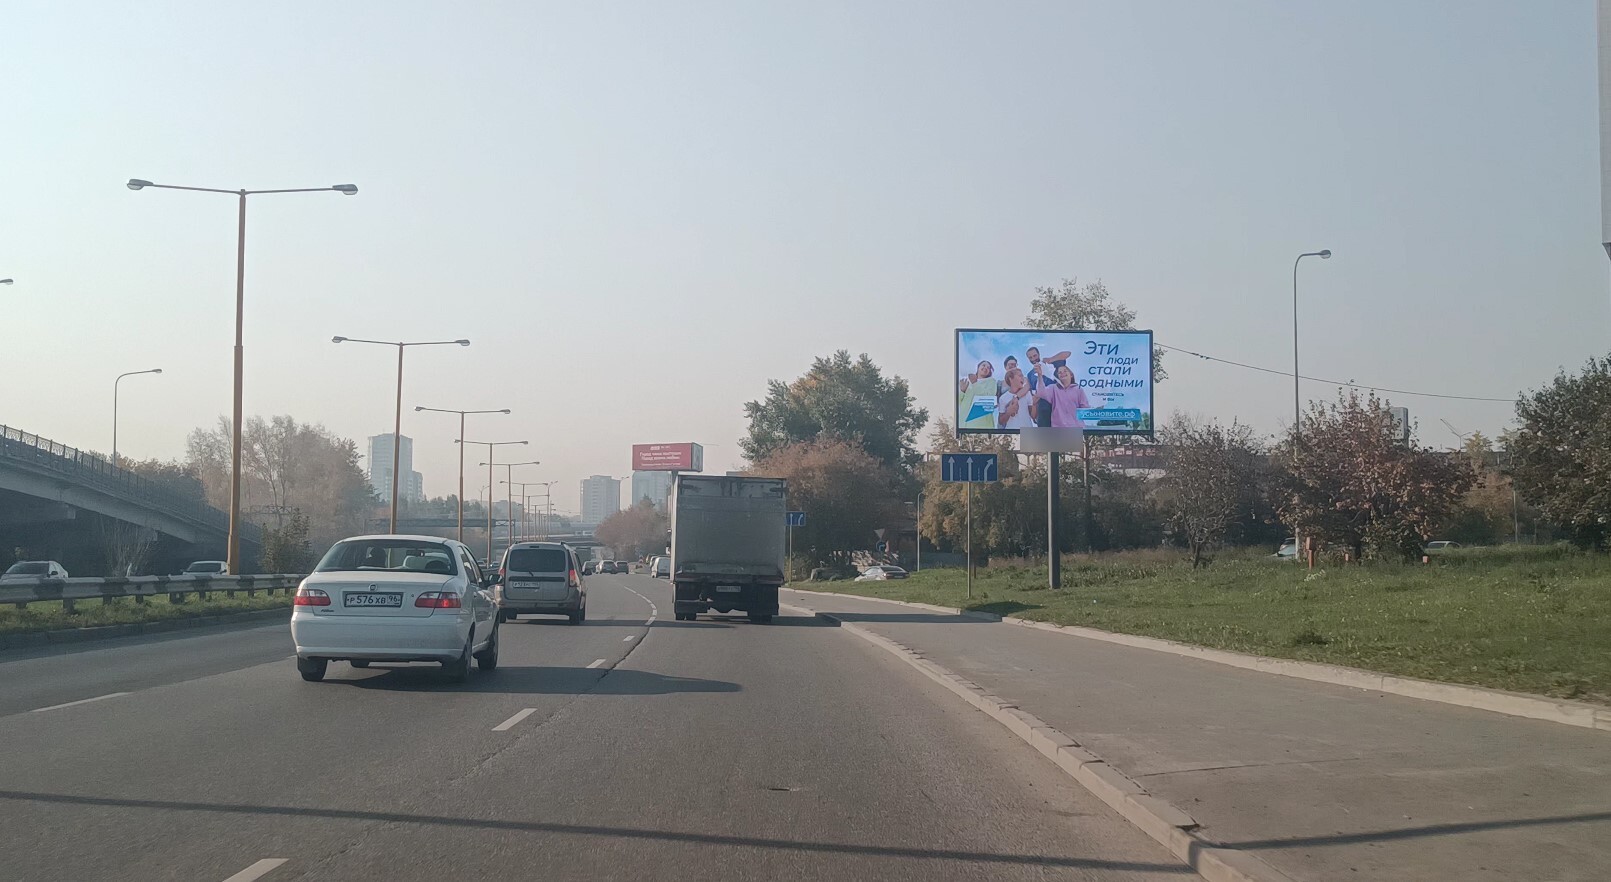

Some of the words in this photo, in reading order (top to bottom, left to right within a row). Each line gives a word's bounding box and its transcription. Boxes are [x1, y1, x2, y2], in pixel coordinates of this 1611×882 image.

[1083, 340, 1119, 355] Эти
[1106, 357, 1138, 365] люди
[1088, 366, 1131, 375] стали
[1078, 379, 1143, 389] родными
[1082, 410, 1136, 418] усыновите.рф
